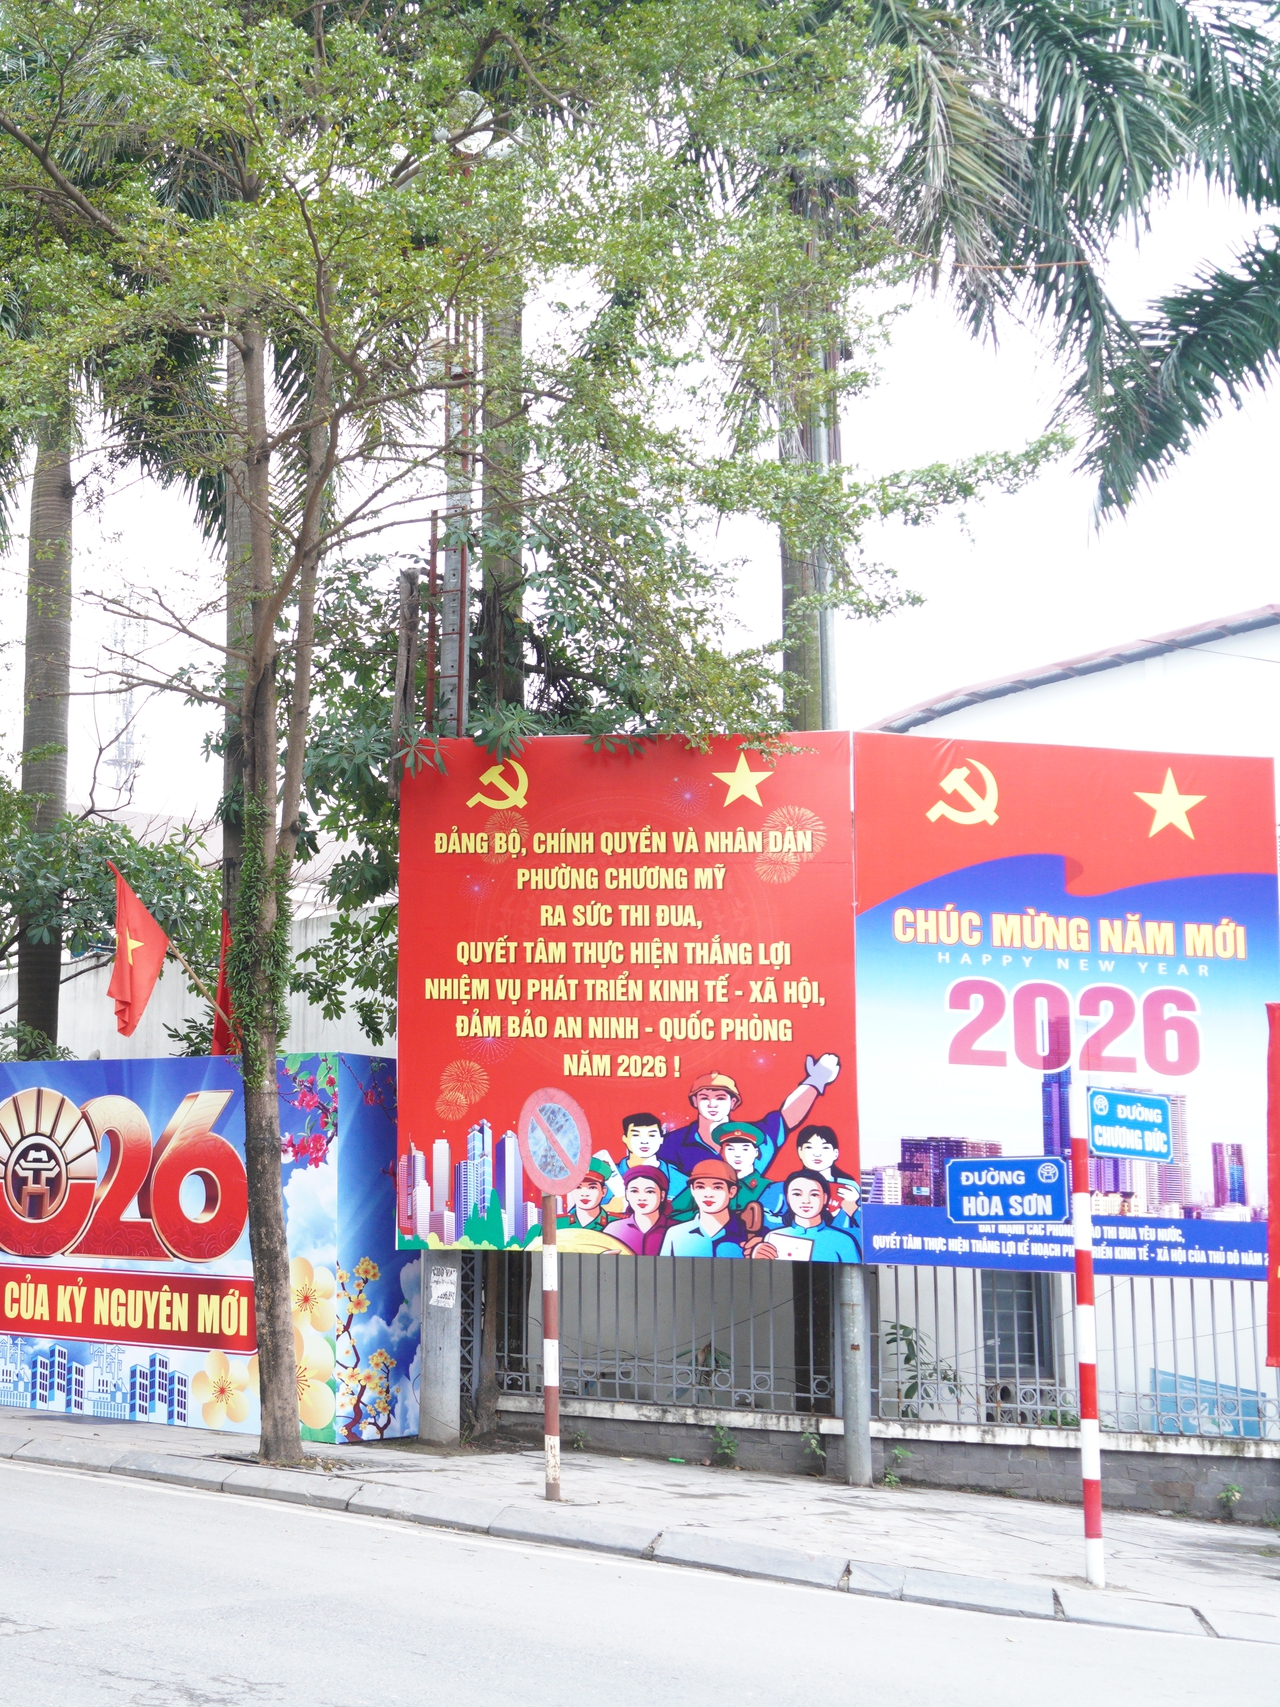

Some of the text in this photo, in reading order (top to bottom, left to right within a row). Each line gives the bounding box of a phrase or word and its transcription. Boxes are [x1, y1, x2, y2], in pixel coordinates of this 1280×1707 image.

[435, 825, 813, 858] ĐẢNG BỘ, CHÍNH QUYỀN VÀ NHÂN DÂN
[518, 863, 725, 889] PHƯỜNG CHƯƠNG MỸ
[541, 901, 702, 929] RA SỨC THI ĐUA,
[893, 904, 1246, 960] CHÚC MỪNG NĂM MỚI
[457, 935, 790, 970] QUYẾT TÂM THỰC HIỆN THẮNG LỢI
[938, 951, 1209, 976] HAPPY NEW YEAR
[426, 974, 489, 1004] NHIỆM
[496, 979, 520, 1004] VỤ
[528, 975, 578, 1000] PHÁT
[584, 971, 642, 1001] TRIỂN
[649, 980, 698, 1001] KINH
[704, 974, 729, 1002] TẾ
[749, 977, 777, 1002] XÃ
[784, 977, 825, 1008] HỘI,
[456, 1009, 500, 1037] ĐẢM
[508, 1009, 547, 1037] BẢO
[554, 1017, 581, 1038] AN
[589, 1017, 638, 1038] NINH
[660, 1010, 714, 1042] QUỐC
[721, 1014, 792, 1041] PHÒNG
[947, 977, 1201, 1077] 2026
[564, 1050, 610, 1076] NĂM
[617, 1055, 664, 1077] 2026
[1117, 1103, 1162, 1123] ĐƯỜNG
[1094, 1124, 1168, 1153] CHƯƠNG ĐỨC
[960, 1167, 1025, 1185] ĐƯỜNG
[963, 1191, 1053, 1216] HÒA SƠN
[998, 1224, 1025, 1237] MẠNH
[1102, 1226, 1117, 1239] THI
[1119, 1227, 1137, 1240] ĐUA
[1138, 1226, 1156, 1241] YÊU
[1157, 1226, 1185, 1243] NƯỚC,
[873, 1231, 901, 1250] QUYẾT
[902, 1234, 922, 1250] TÂM
[923, 1237, 946, 1253] THỰC
[948, 1237, 969, 1255] HIỆN
[971, 1236, 1000, 1254] THẮNG
[1002, 1241, 1016, 1257] LỢI
[1017, 1238, 1030, 1255] KẾ
[1031, 1243, 1061, 1259] HOẠCH
[1091, 1241, 1114, 1259] RIỂN
[1114, 1246, 1136, 1260] KINH
[1138, 1244, 1149, 1260] TẾ
[1156, 1246, 1170, 1261] XÃ
[1171, 1247, 1187, 1265] HỘI
[1188, 1245, 1207, 1263] CỦA
[1208, 1246, 1226, 1264] THỦ
[1227, 1250, 1240, 1265] ĐÔ
[1241, 1250, 1263, 1266] NĂM
[5, 1274, 49, 1320] CỦA
[57, 1277, 87, 1323] KỶ
[94, 1285, 188, 1331] NGUYÊN
[198, 1289, 247, 1336] MỚI
